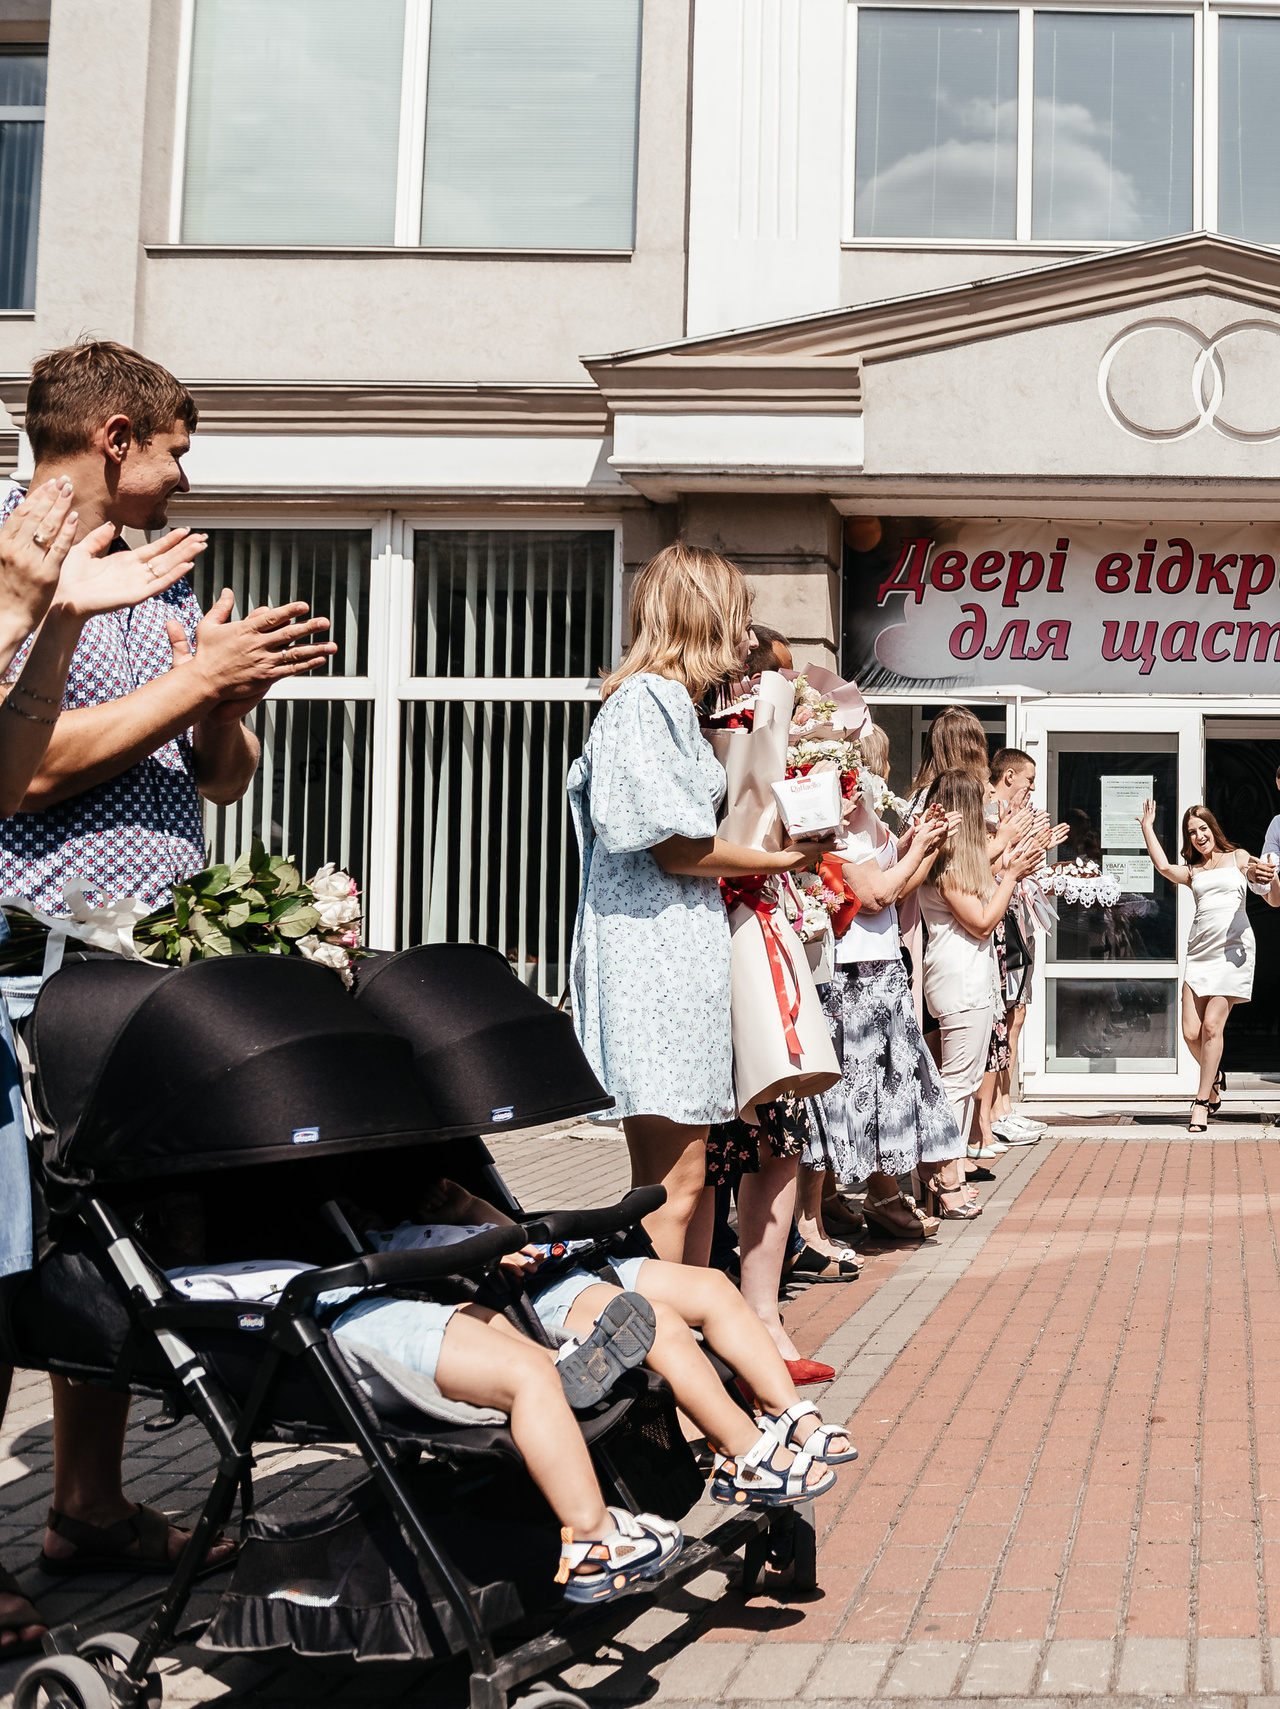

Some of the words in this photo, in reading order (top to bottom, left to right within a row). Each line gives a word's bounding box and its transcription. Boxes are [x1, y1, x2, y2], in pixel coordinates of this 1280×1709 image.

[876, 537, 1070, 608] Двері
[949, 603, 1071, 660] для
[790, 782, 821, 793] Raffaello
